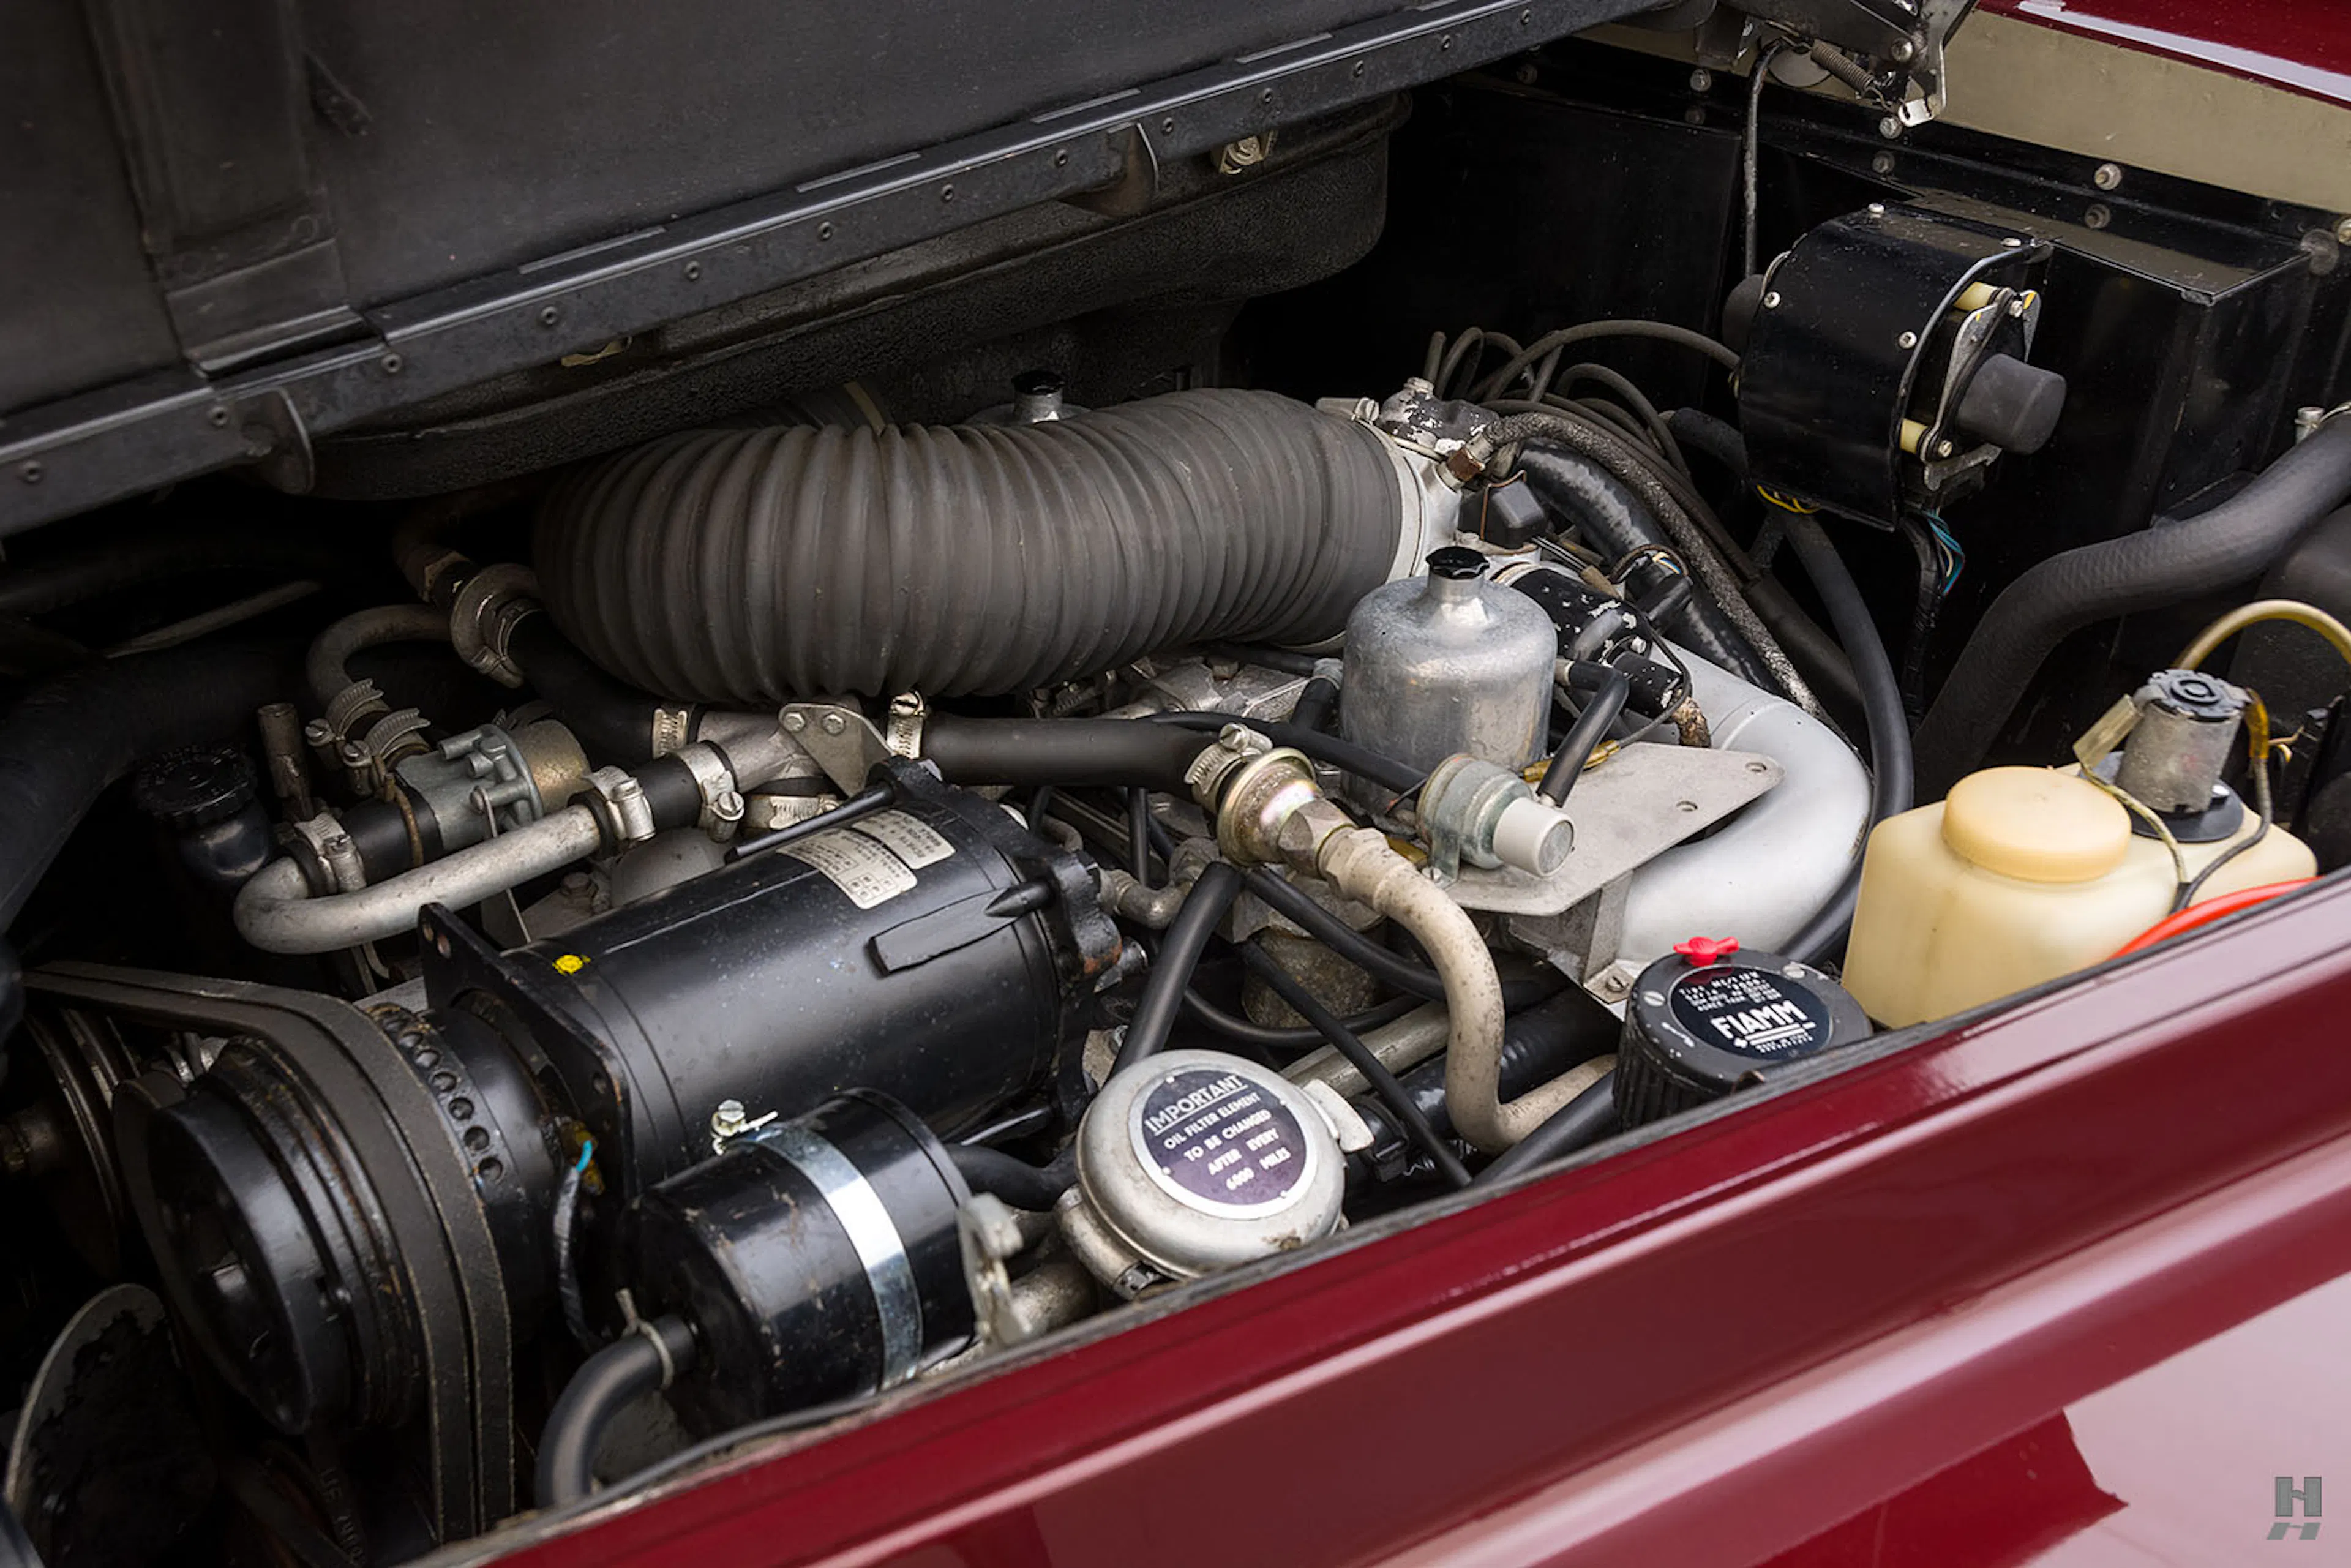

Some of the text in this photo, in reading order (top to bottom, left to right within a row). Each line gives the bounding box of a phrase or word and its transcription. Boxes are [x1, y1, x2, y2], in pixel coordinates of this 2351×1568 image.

[1710, 1000, 1809, 1039] FIAMM
[1144, 1075, 1243, 1132] IMPORTANT
[1164, 1092, 1261, 1149] OIL FILTER ELEMENT
[1183, 1109, 1272, 1161] TO BE CHANGED
[1207, 1128, 1279, 1176] AFTER EVERY
[1259, 1147, 1291, 1170] MILES
